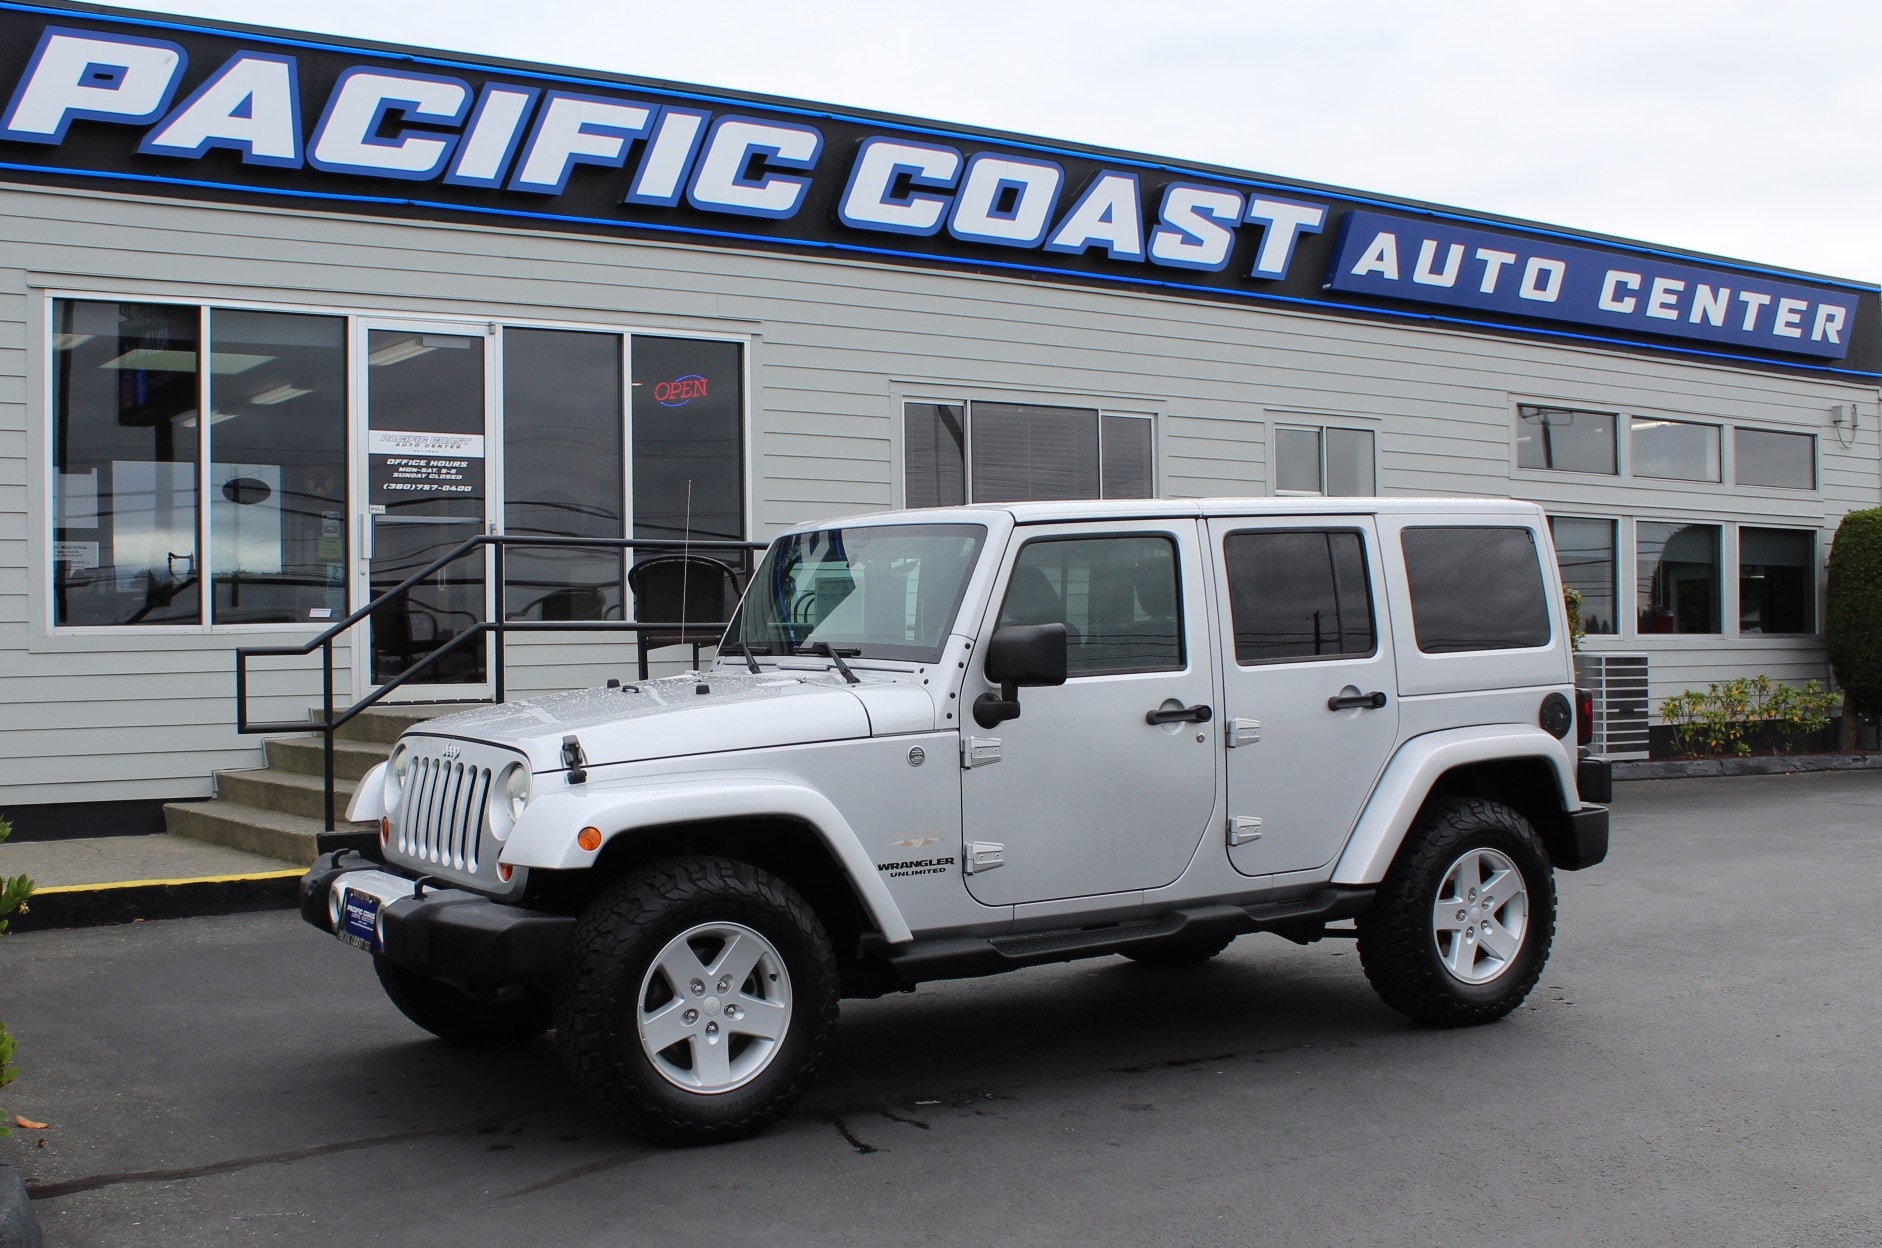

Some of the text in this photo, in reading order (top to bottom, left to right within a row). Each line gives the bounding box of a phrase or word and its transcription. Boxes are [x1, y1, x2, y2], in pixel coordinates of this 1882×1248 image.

[2, 26, 1329, 282] PACIFIC COAST
[1350, 231, 1847, 344] AUTO CENTER
[654, 378, 709, 401] OPEN
[380, 434, 472, 446] PACIFIC COAST
[442, 742, 461, 760] Jeep
[877, 857, 955, 872] WRANGLER
[890, 867, 947, 878] UNLIMITED
